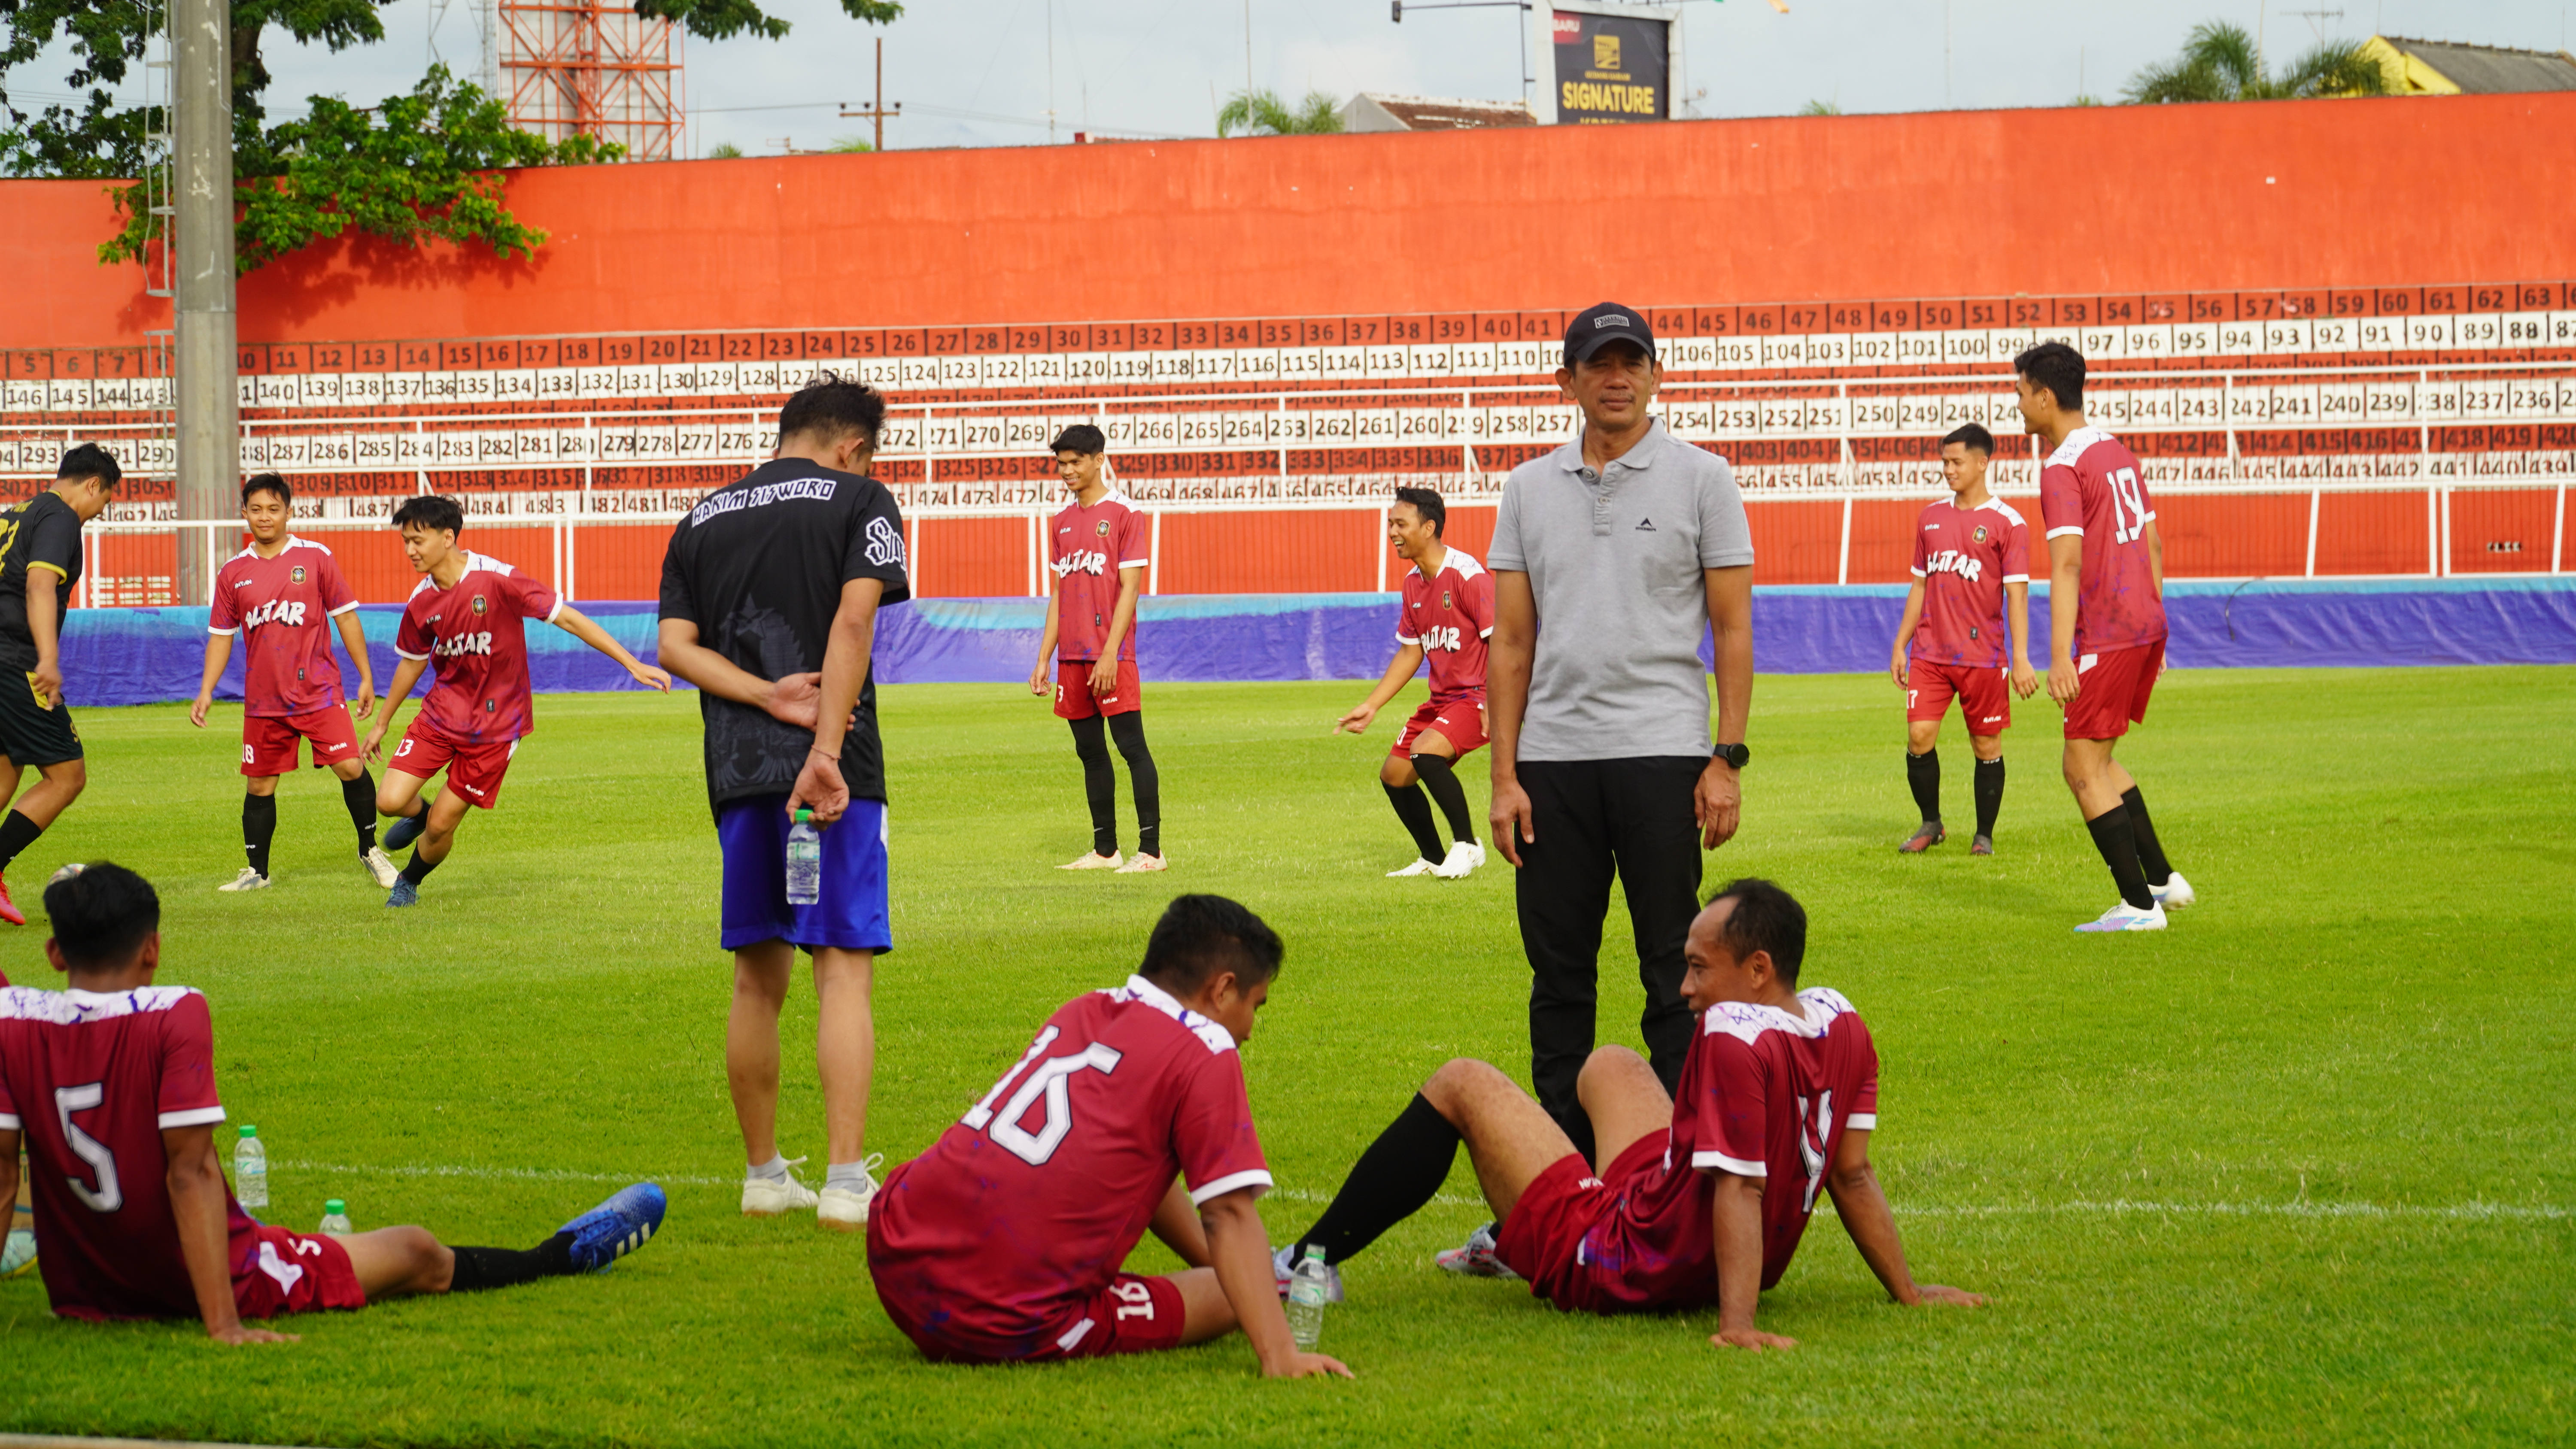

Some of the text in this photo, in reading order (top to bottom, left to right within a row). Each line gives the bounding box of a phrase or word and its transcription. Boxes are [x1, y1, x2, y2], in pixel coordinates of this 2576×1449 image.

[1562, 81, 1655, 114] SIGNATURE
[25, 288, 2550, 373] 5 6 7 11 12 13 14 15 16 17 18 19 20 21 22 23 24 25 26 27 28 29 30 31 32 33 34 35 36 37 38 39 40 41 44 45 46 47 48 49 50 51 52 53 54 56 57 59 60 61 62 63
[7, 322, 2538, 404] 146 145 144 140 139 138 137 135 134 133 132 131 130 129 128 125 124 123 122 121 120 119 118 117 116 115 114 113 112 111 110 106 105 104 103 102 101 100 97 96 95 94 93 92 91 90 89 88
[273, 391, 2550, 459] 287 286 285 283 278 277 269 266 265 262 260 258 257 254 253 250 249 240 237 236
[691, 478, 837, 528] HAKIM SISWORO
[2106, 466, 2146, 545] 19
[1059, 549, 1106, 579] BLITAR
[394, 739, 414, 757] 13
[960, 1025, 1124, 1166] 16
[55, 1081, 123, 1212] 5
[288, 1237, 322, 1257] 5
[1109, 1280, 1154, 1320] 16
